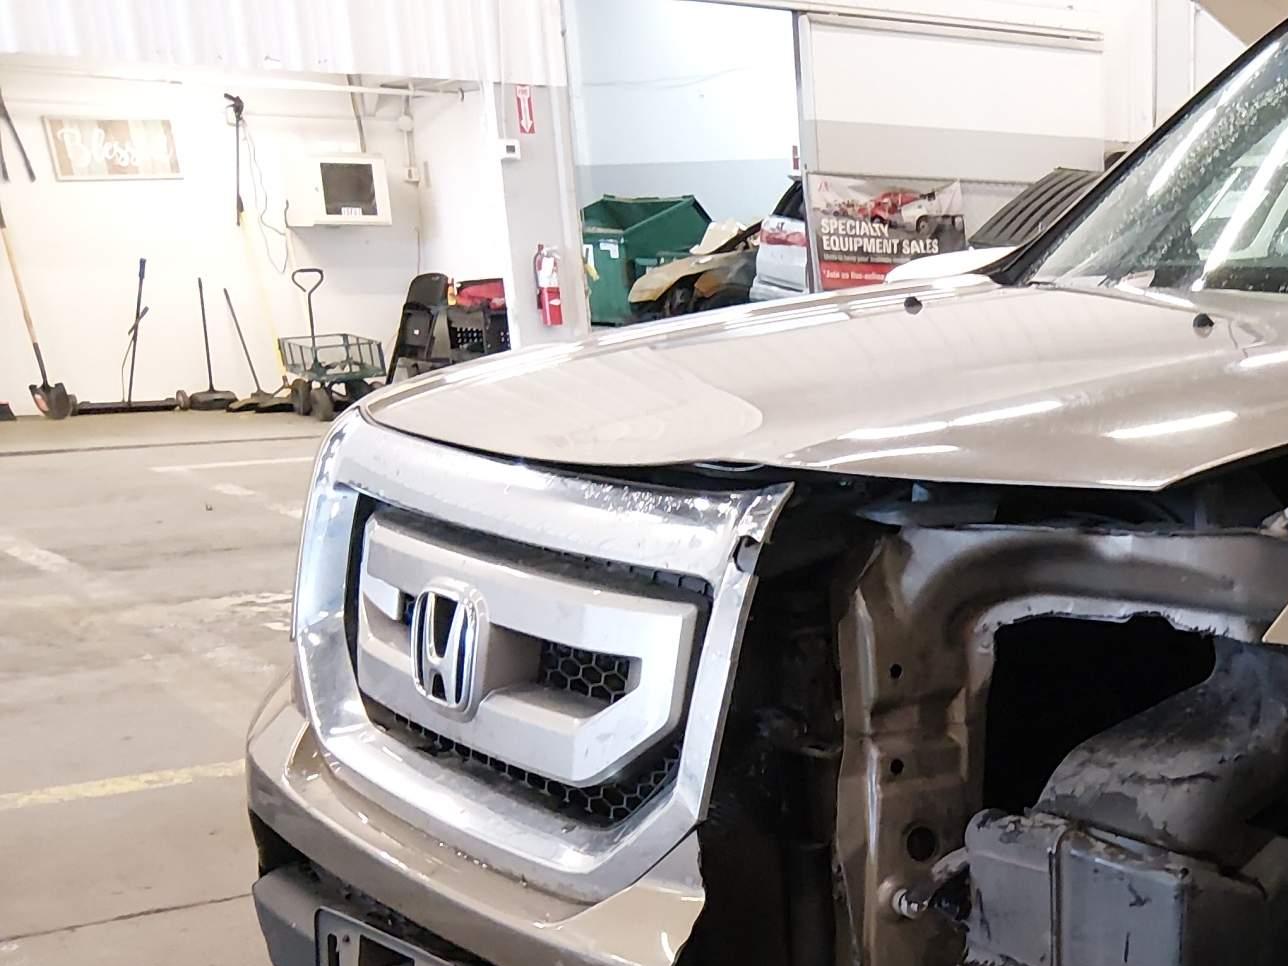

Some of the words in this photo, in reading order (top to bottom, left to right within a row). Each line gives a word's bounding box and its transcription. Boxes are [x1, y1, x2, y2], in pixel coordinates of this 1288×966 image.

[821, 217, 889, 238] SPECIALTY
[822, 235, 900, 254] EQUIPMENT
[902, 238, 939, 254] SALES
